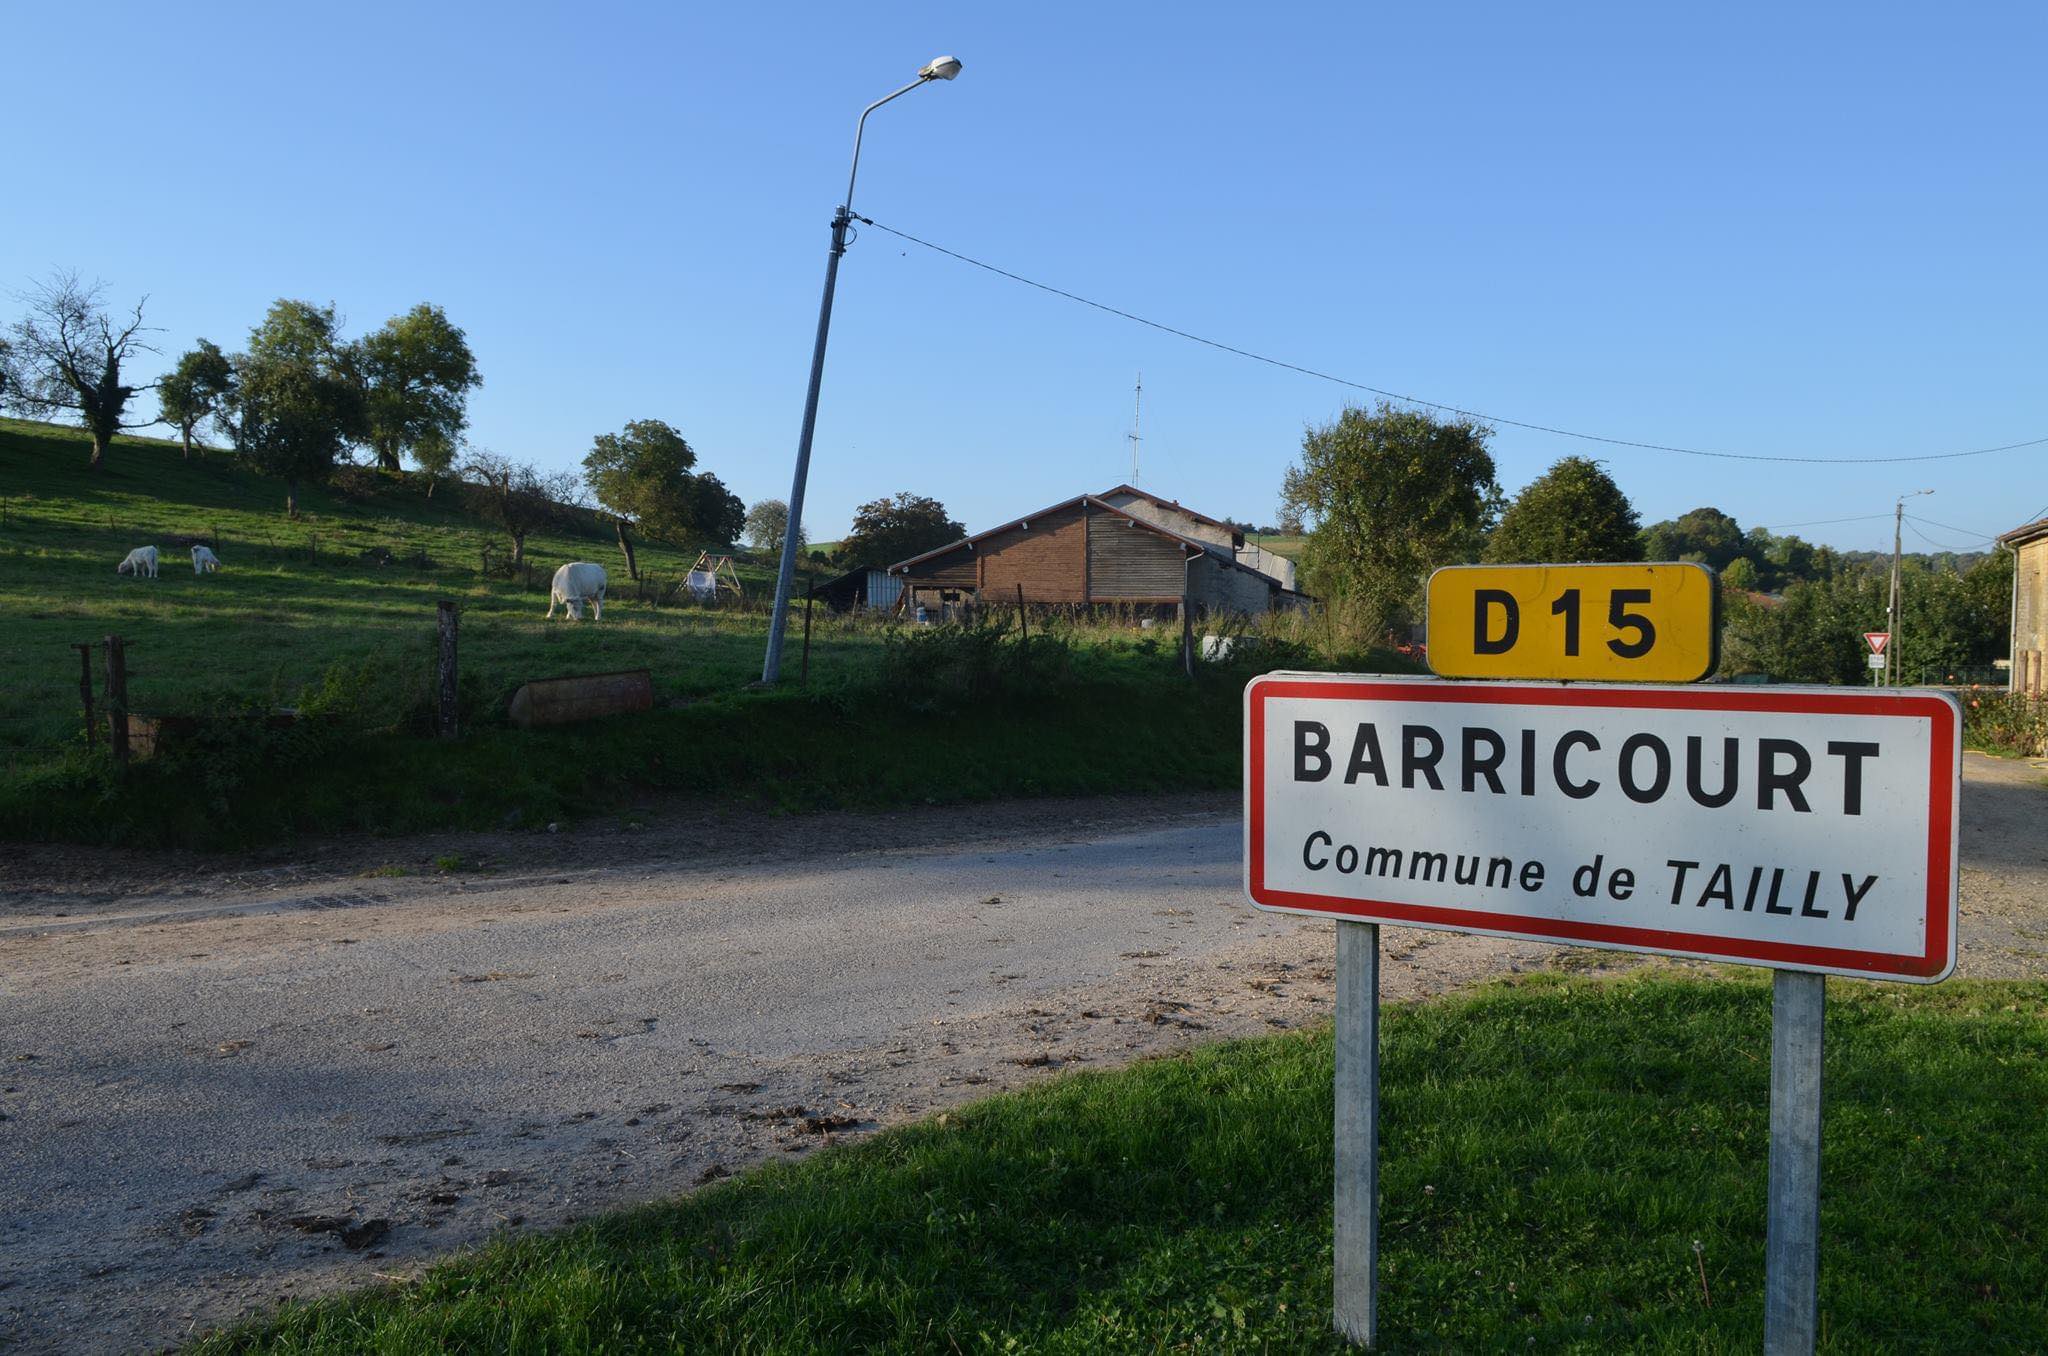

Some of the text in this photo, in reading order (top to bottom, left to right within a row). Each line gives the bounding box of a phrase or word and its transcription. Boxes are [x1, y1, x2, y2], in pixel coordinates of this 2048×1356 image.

[1294, 720, 1880, 816] BARRICOURT
[1302, 830, 1879, 922] Commune de TAILLY
